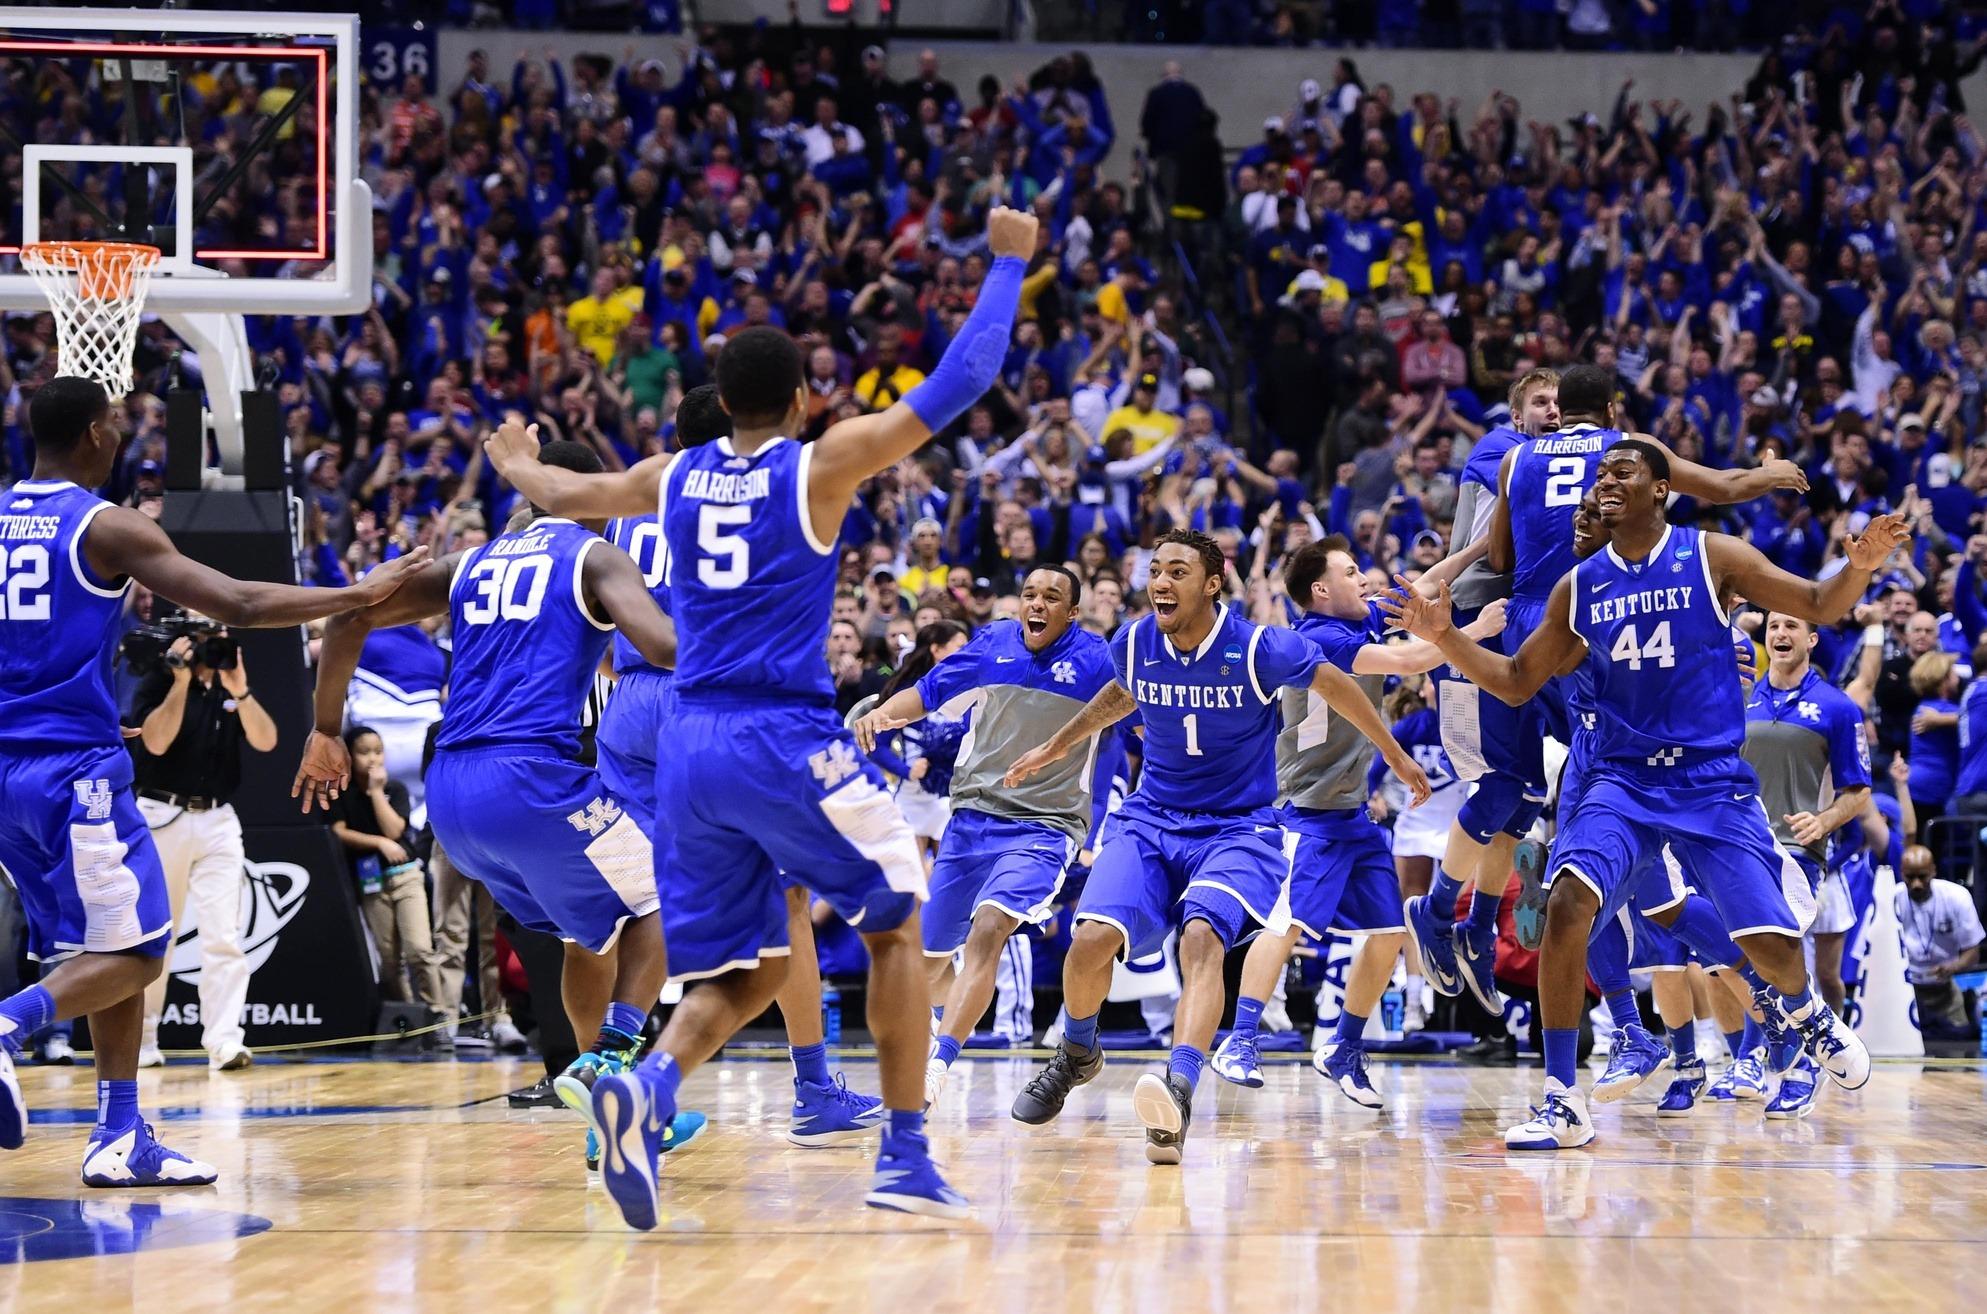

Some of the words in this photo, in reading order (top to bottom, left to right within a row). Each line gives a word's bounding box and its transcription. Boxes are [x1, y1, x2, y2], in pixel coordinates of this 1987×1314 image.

[372, 42, 428, 80] 36
[1533, 435, 1603, 454] HARRISON
[681, 467, 771, 503] HARRISON
[1545, 456, 1586, 508] 2
[629, 521, 674, 589] 0
[697, 504, 752, 590] 5
[0, 544, 51, 621] 2
[463, 553, 554, 625] 30
[1590, 586, 1692, 624] KENTUCKY
[1610, 620, 1675, 671] 44
[1136, 679, 1244, 708] KENTUCKY
[1183, 713, 1204, 756] 1
[73, 778, 113, 819] UK
[566, 796, 622, 837] UK
[161, 1003, 322, 1025] ASTBALL
